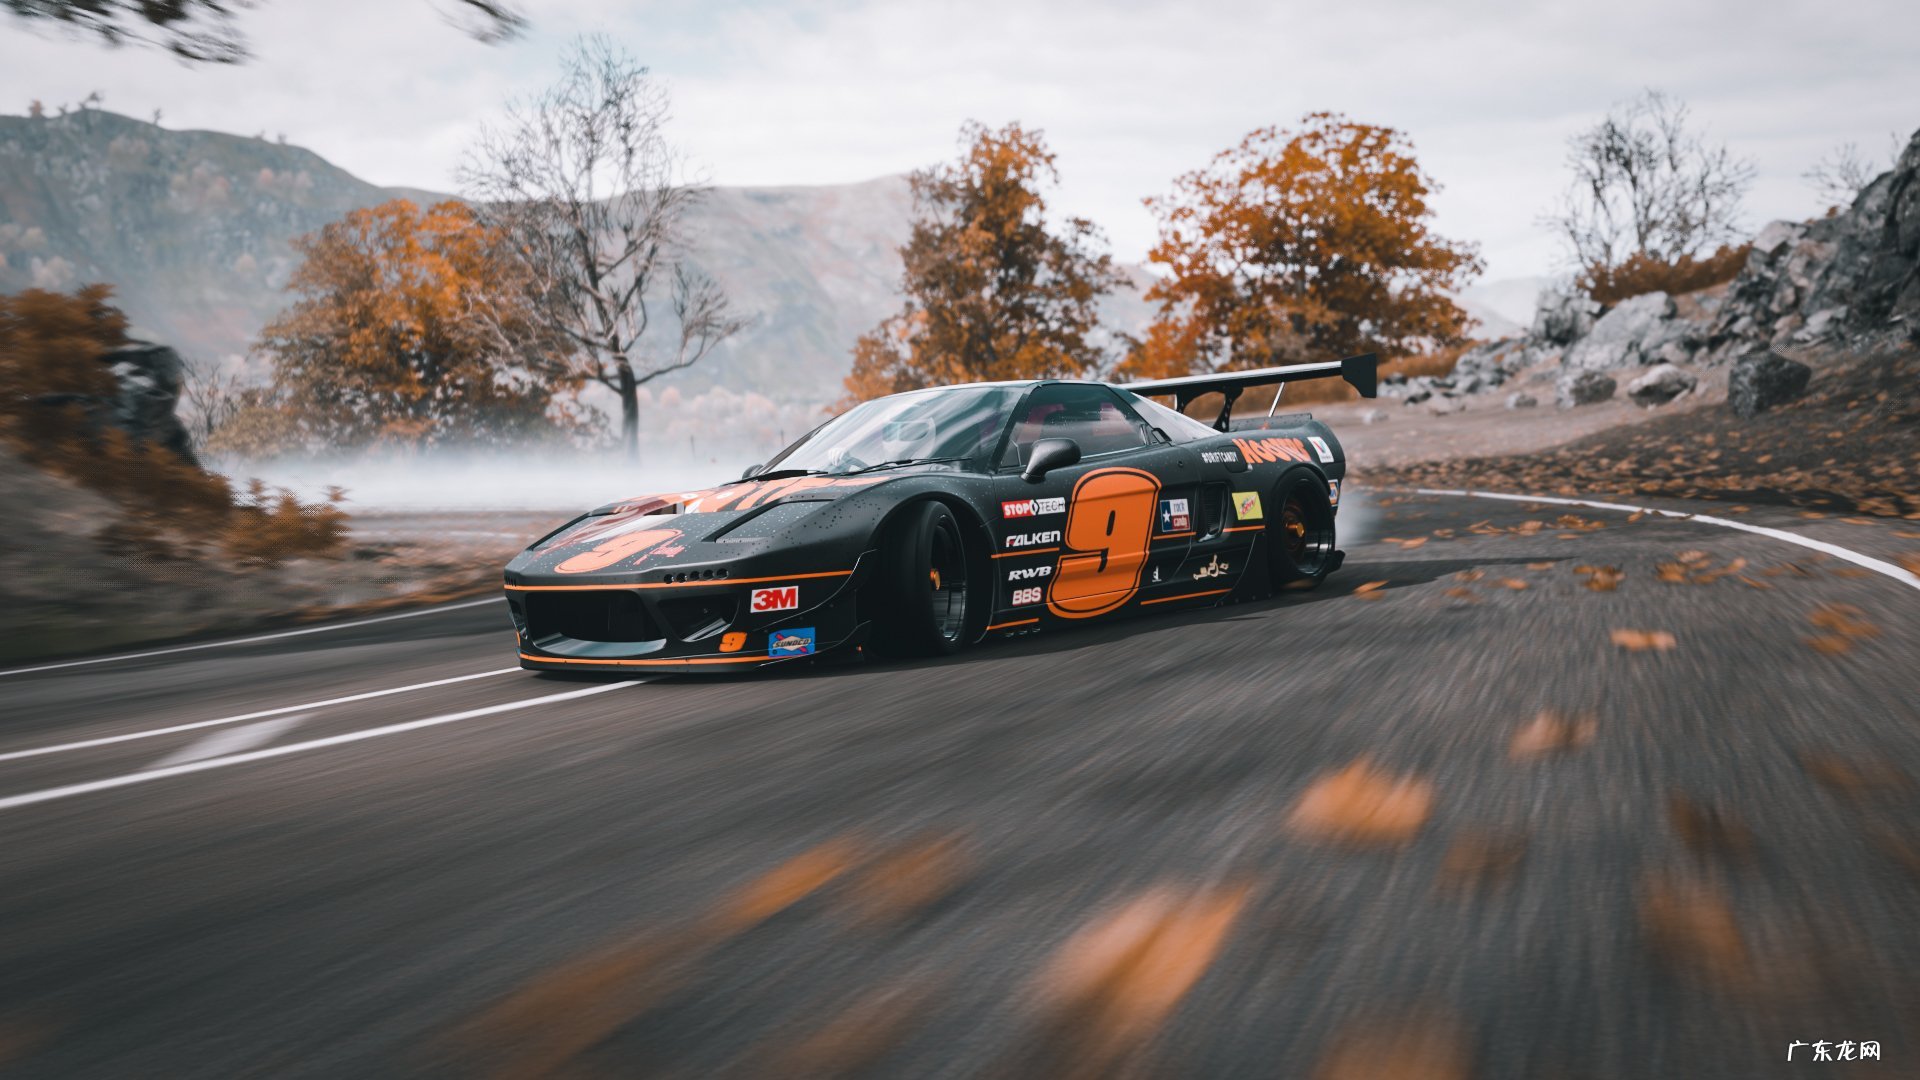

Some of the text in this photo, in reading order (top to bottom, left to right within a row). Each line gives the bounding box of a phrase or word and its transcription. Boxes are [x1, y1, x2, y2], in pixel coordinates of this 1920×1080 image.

[1005, 530, 1061, 548] FALKEN
[1047, 467, 1162, 619] 9
[554, 528, 682, 574] 9
[1008, 565, 1052, 581] RWB
[753, 587, 797, 611] 3M
[1012, 586, 1042, 606] BBS
[718, 631, 748, 653] 9
[774, 639, 810, 649] SUNOCO
